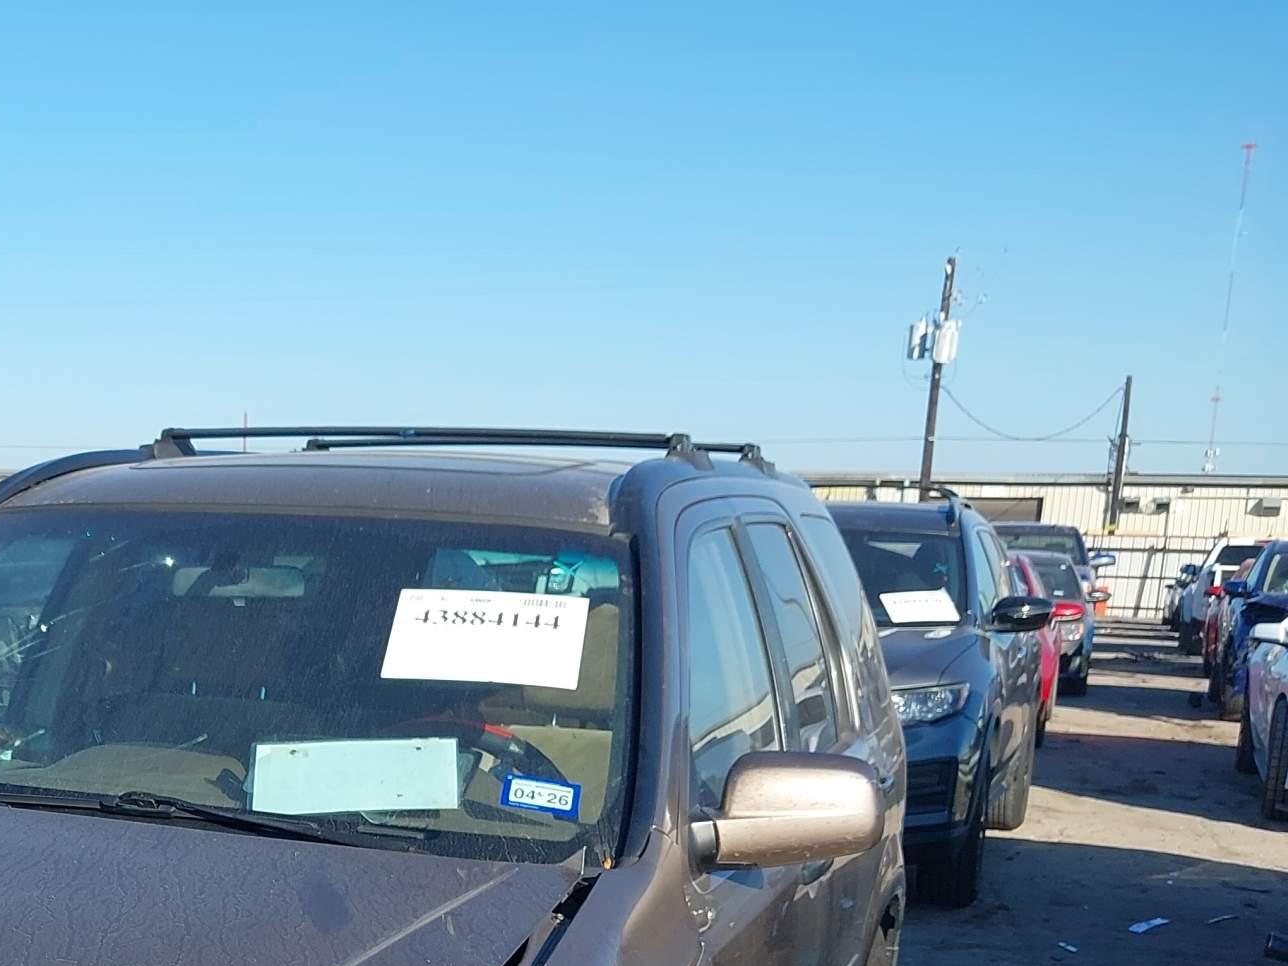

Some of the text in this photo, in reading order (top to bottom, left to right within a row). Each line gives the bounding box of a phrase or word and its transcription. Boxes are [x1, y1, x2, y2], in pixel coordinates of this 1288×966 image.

[415, 609, 561, 630] 43884144
[513, 787, 536, 801] 04
[546, 792, 569, 806] 26
